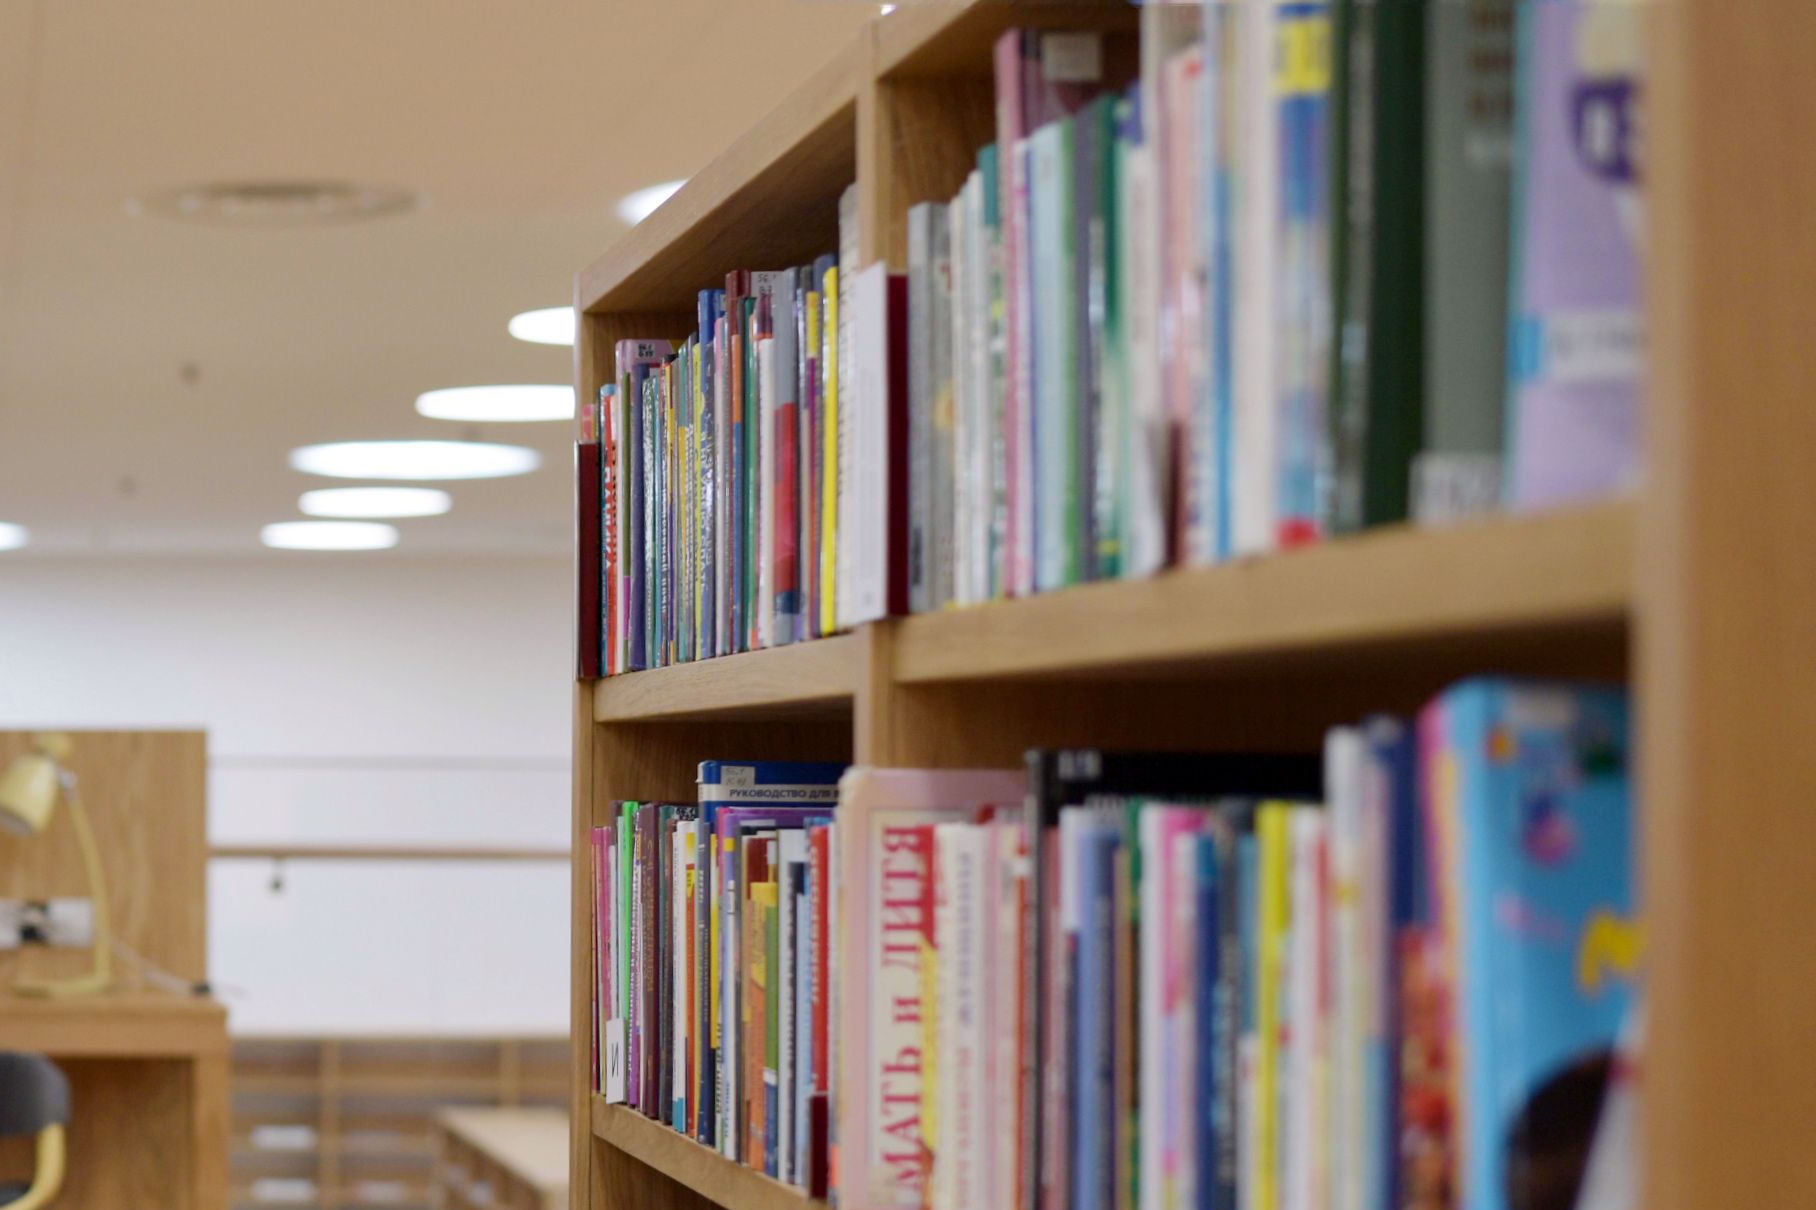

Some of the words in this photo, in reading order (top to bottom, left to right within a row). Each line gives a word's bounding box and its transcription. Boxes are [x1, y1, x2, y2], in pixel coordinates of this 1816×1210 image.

[729, 788, 808, 799] РУКОВОДСТВО
[809, 788, 831, 800] ДЛЯ
[892, 997, 922, 1024] и
[881, 1045, 922, 1190] МАТЬ
